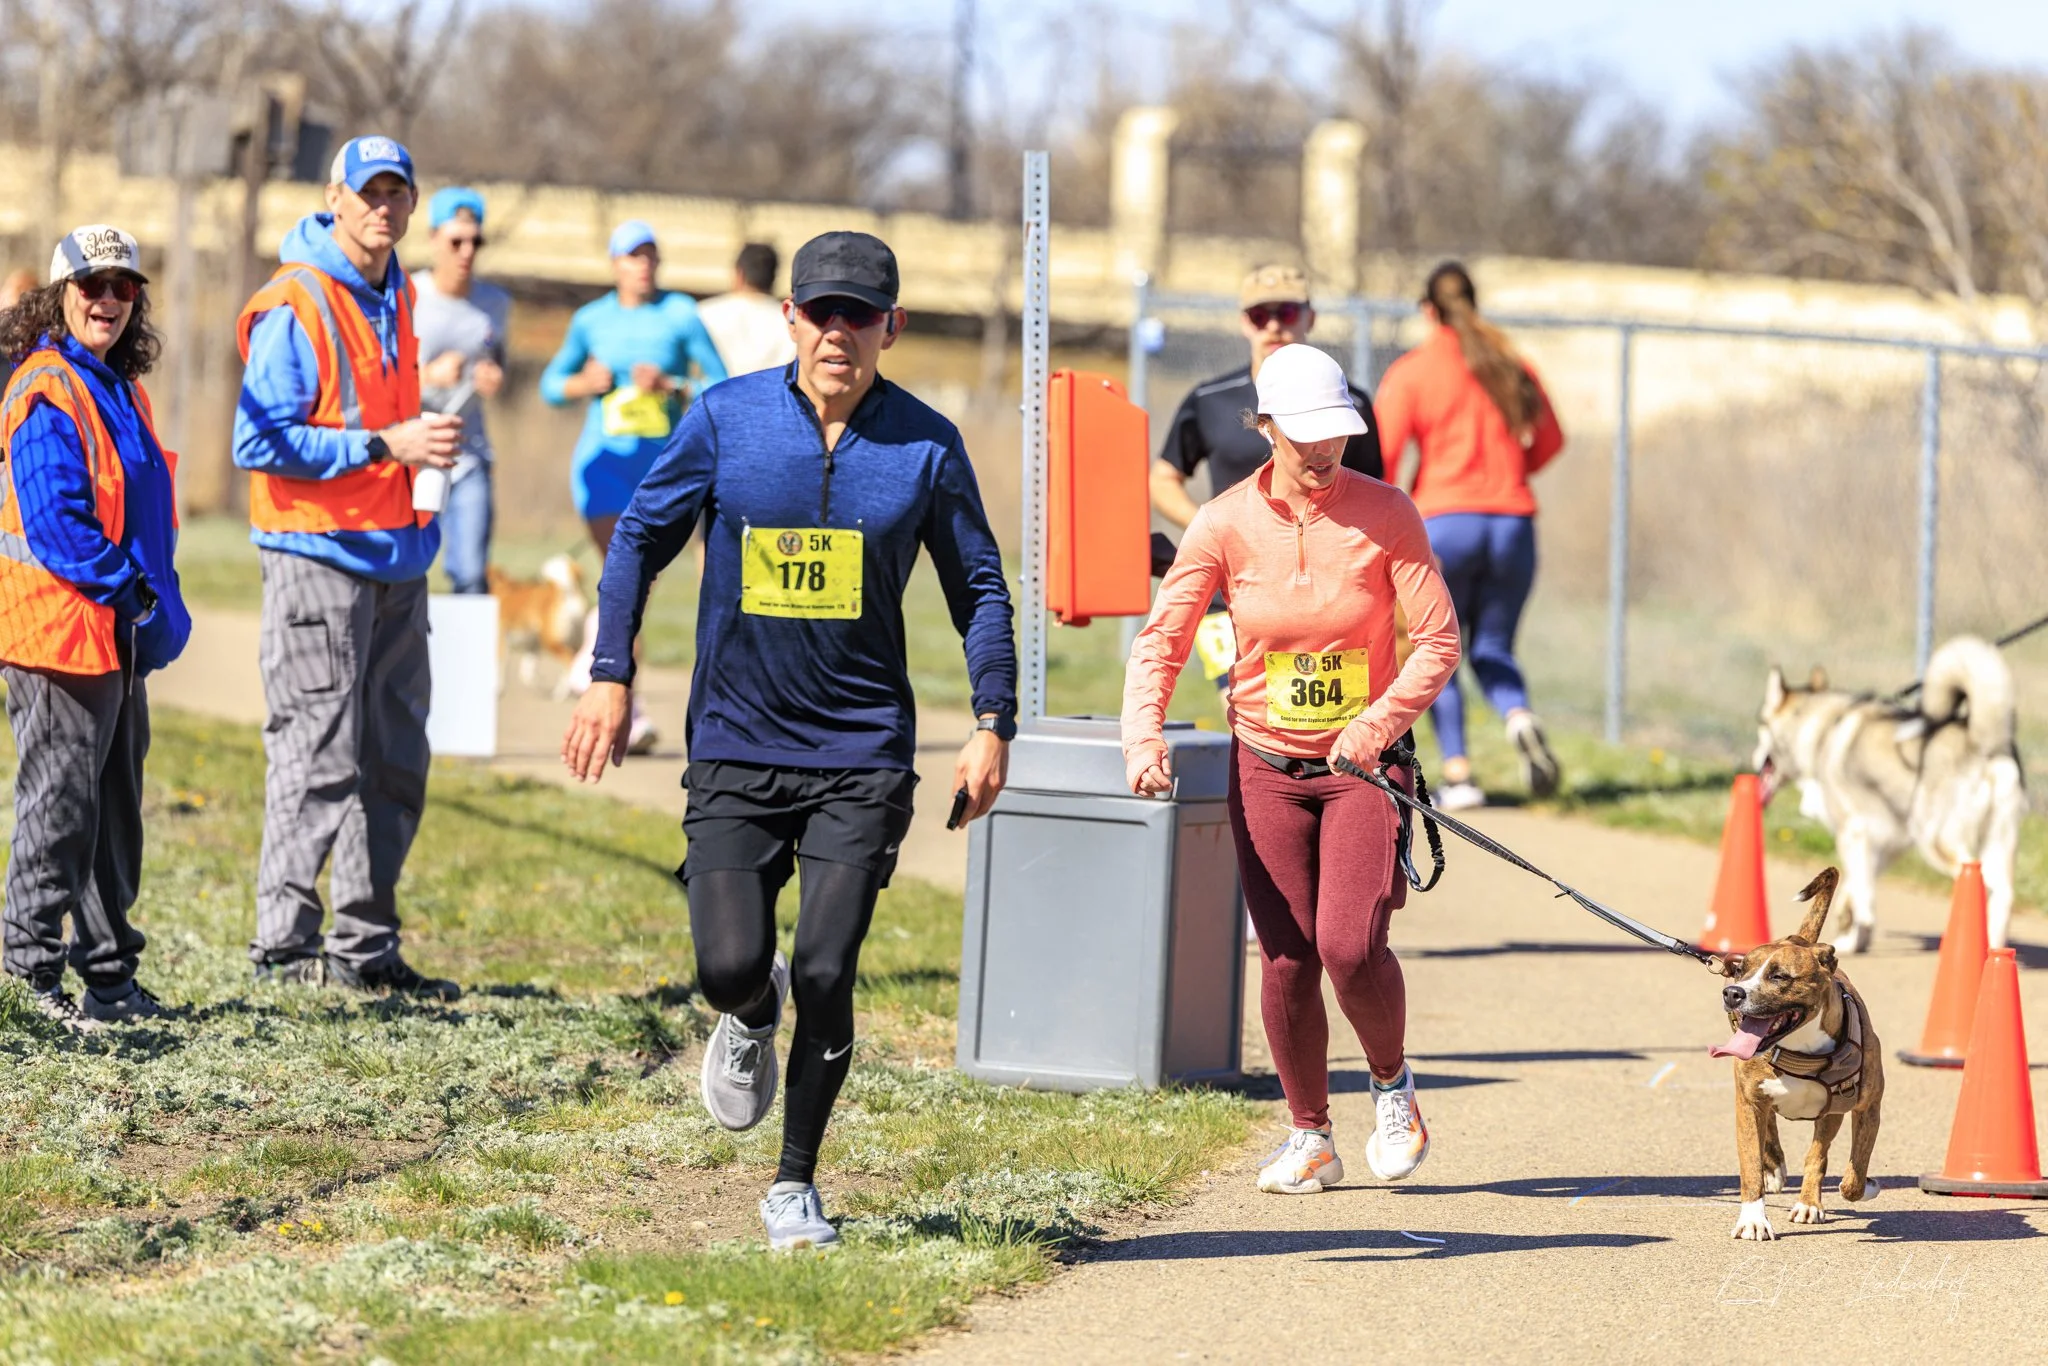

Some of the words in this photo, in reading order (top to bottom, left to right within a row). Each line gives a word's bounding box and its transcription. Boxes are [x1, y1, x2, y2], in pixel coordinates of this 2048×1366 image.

[809, 534, 832, 552] 5K
[777, 561, 826, 592] 178
[1321, 654, 1343, 672] 5K
[1290, 677, 1344, 708] 364
